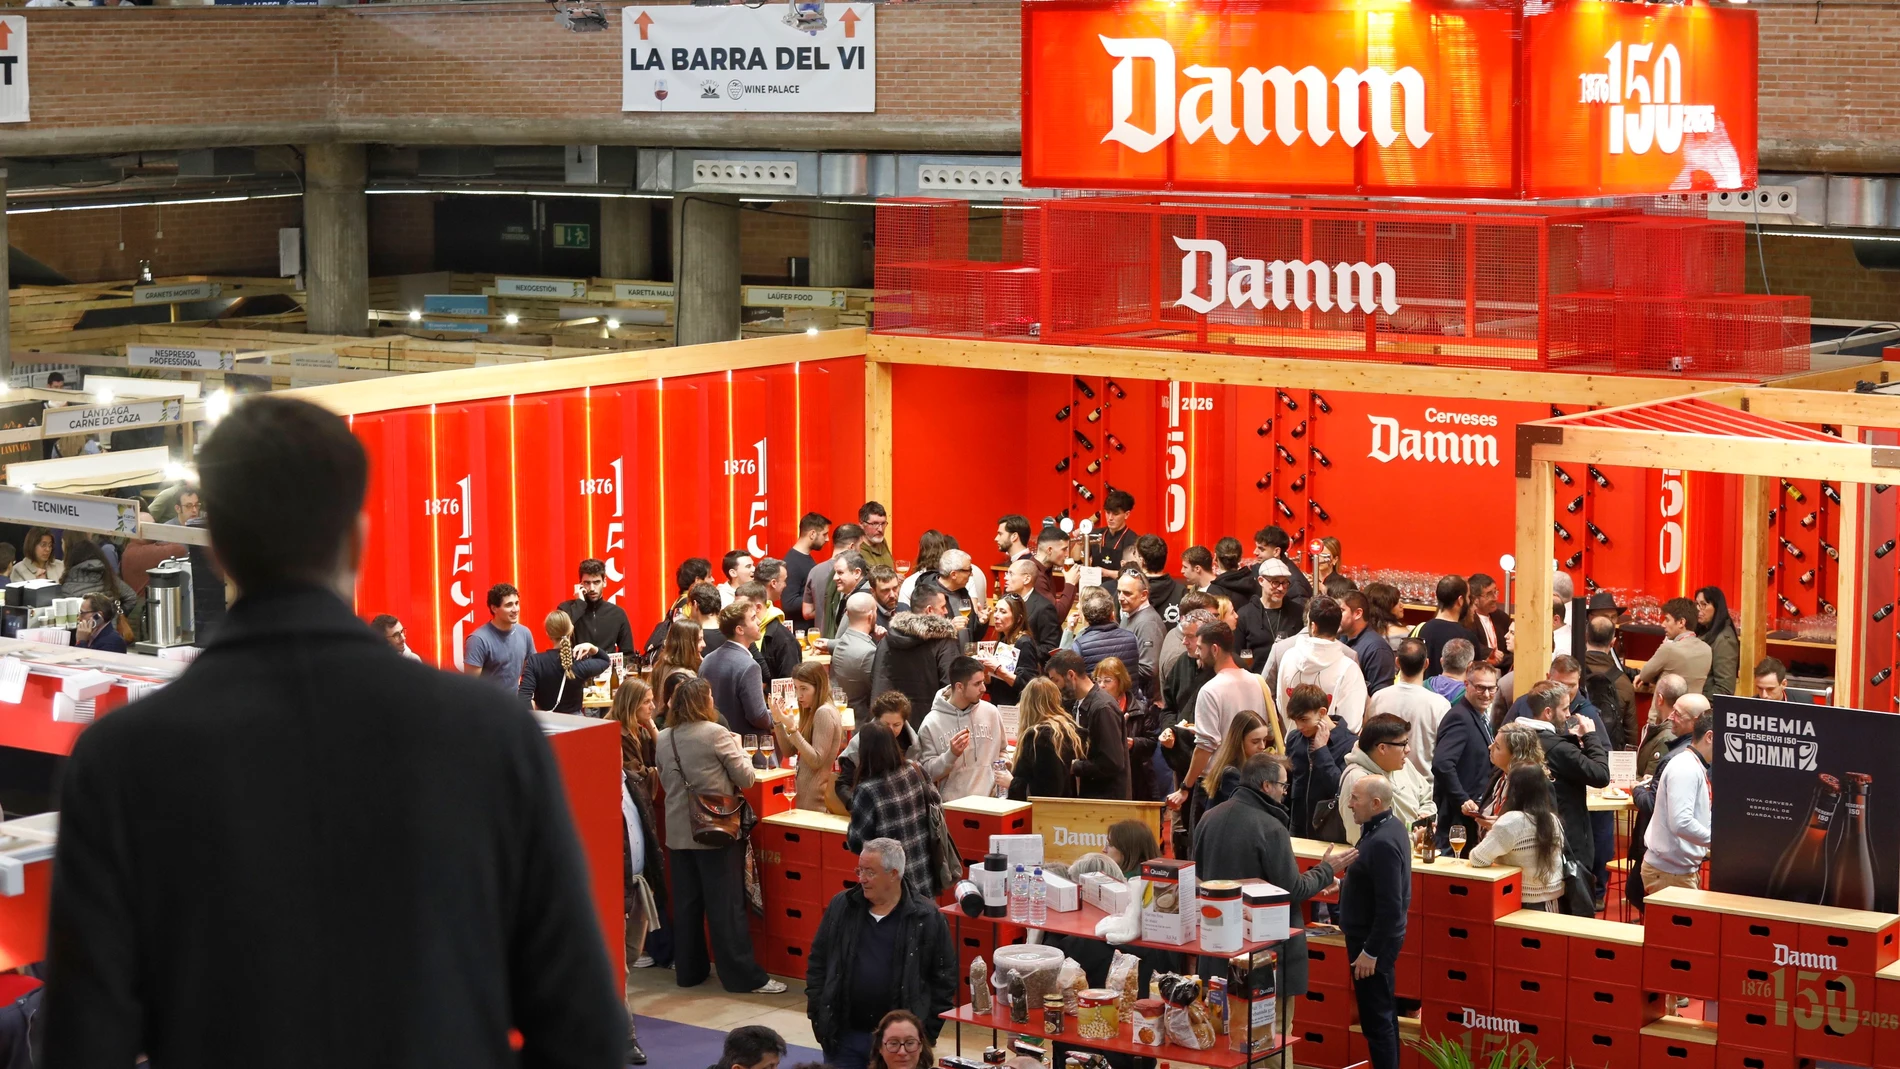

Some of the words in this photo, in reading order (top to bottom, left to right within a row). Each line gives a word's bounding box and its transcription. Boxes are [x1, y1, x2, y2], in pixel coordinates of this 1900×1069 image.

[631, 48, 665, 71] LA
[671, 47, 768, 71] BARRA
[775, 46, 830, 70] DEL
[837, 46, 865, 70] VI
[0, 56, 18, 85] T
[744, 85, 766, 93] WINE
[768, 85, 800, 93] PALACE
[1097, 33, 1435, 154] Damm
[1604, 41, 1684, 155] 150
[1172, 235, 1402, 315] Damm
[145, 290, 172, 299] GRANETS
[515, 283, 557, 293] NEXOGESTIÓN
[628, 288, 656, 297] KARETTA
[793, 294, 813, 302] FOOD
[149, 357, 202, 367] PROFESSIONAL
[155, 349, 196, 359] NESPRESSO
[82, 405, 130, 419] LANTXAGA
[1181, 397, 1214, 411] 2026
[69, 417, 101, 430] CARNE
[102, 415, 115, 426] DE
[117, 413, 141, 424] CAZA
[1424, 407, 1498, 427] Cerveses
[1366, 414, 1501, 468] Damm
[723, 459, 756, 476] 1876
[579, 478, 613, 495] 1876
[32, 500, 80, 517] TECNIMEL
[424, 499, 459, 516] 1876
[772, 684, 794, 694] DAMM
[1726, 711, 1816, 737] BOHEMIA
[1745, 732, 1783, 744] RESERVA
[1784, 737, 1797, 745] 150
[1745, 742, 1796, 769] DAMM
[1749, 804, 1780, 813] ESPECIAL
[1764, 799, 1794, 807] CERVESA
[1746, 811, 1772, 819] GUARDA
[1773, 813, 1793, 821] LENTA
[1150, 868, 1170, 878] Quality
[1772, 943, 1838, 971] Damm
[1741, 980, 1772, 998] 1876
[1771, 968, 1859, 1035] 150
[1861, 1010, 1899, 1029] 2026
[1461, 1006, 1521, 1035] Damm
